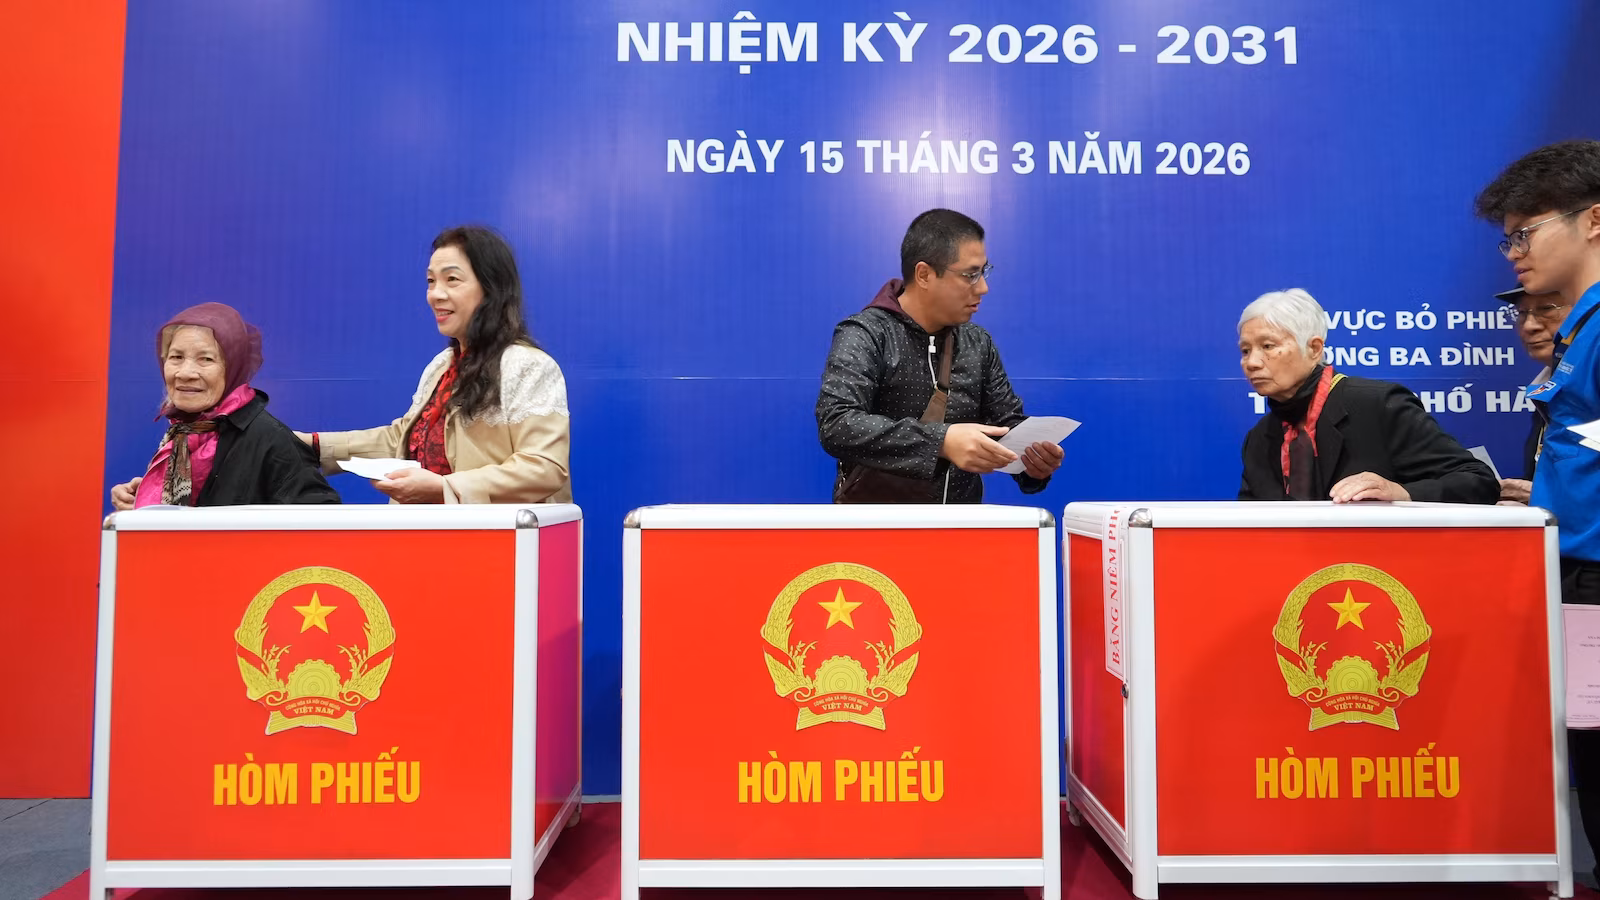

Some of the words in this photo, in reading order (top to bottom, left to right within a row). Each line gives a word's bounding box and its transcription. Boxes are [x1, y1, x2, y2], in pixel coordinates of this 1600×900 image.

[617, 11, 818, 74] NHIỆM
[843, 11, 928, 62] KỲ
[948, 24, 1099, 63] 2026
[1118, 44, 1137, 53] -
[1156, 25, 1298, 64] 2031
[666, 130, 784, 174] NGÀY
[800, 141, 844, 174] 15
[857, 131, 998, 174] THÁNG
[1011, 141, 1035, 174] 3
[1048, 132, 1142, 174] NĂM
[1155, 142, 1251, 175] 2026
[1324, 308, 1387, 336] VỰC
[1395, 303, 1437, 330] BỎ
[1447, 303, 1516, 330] PHIẾ
[1390, 347, 1432, 366] BA
[1440, 342, 1514, 366] ĐÌNH
[1413, 383, 1473, 413] HỐ
[1486, 386, 1537, 412] HÀ
[294, 706, 313, 714] VIỆT
[315, 706, 335, 715] NAM
[822, 702, 841, 710] VIỆT
[843, 702, 862, 711] NAM
[1334, 702, 1353, 710] VIỆT
[1355, 702, 1374, 711] NAM
[213, 753, 299, 806] HÒM
[311, 746, 421, 804] PHIẾU
[738, 750, 822, 803] HÒM
[835, 745, 945, 803] PHIẾU
[1255, 746, 1339, 800] HÒM
[1351, 742, 1460, 798] PHIẾU
